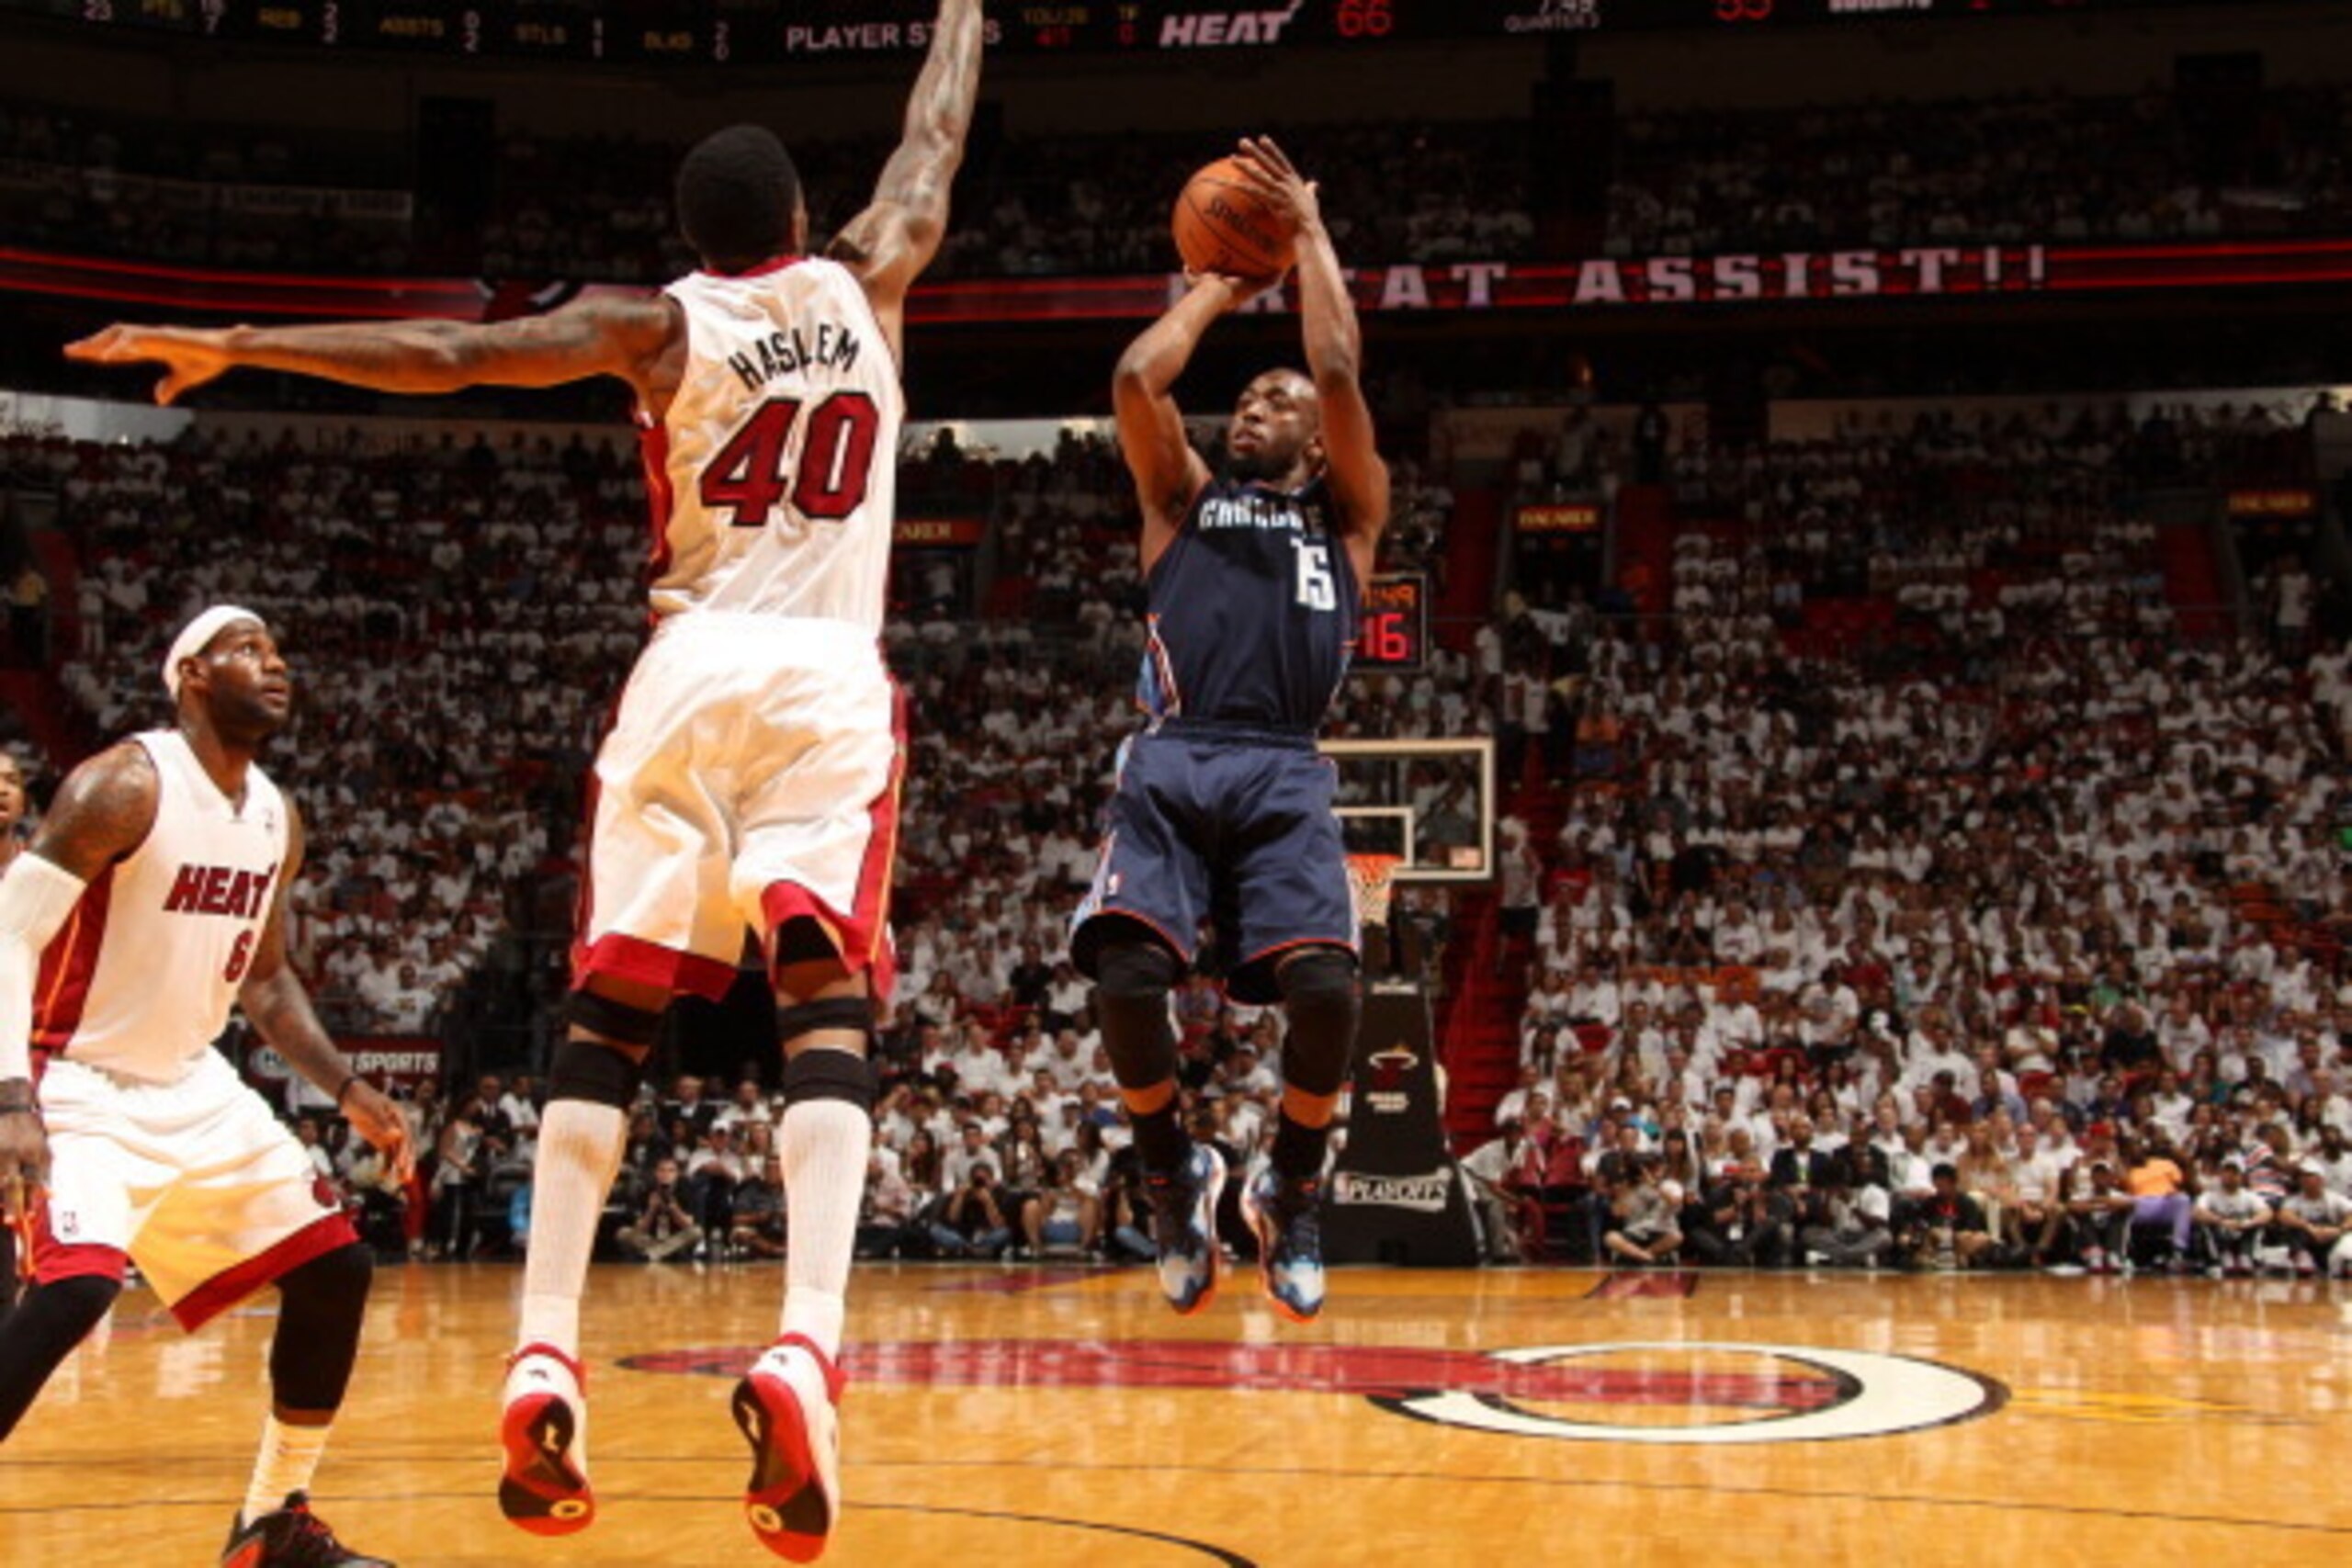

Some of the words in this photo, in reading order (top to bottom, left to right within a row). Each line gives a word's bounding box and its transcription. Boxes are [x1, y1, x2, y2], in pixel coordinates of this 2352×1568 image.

[786, 20, 899, 53] PLAYER
[1159, 6, 1298, 47] HEAT
[1572, 244, 2047, 307] ASSIST!!
[728, 323, 860, 390] HASLEM
[699, 390, 879, 526] 40
[1289, 535, 1337, 612] 15
[1364, 603, 1408, 661] 16
[163, 862, 277, 919] HEAT
[222, 930, 254, 983] 6
[356, 1051, 440, 1074] SPORTS
